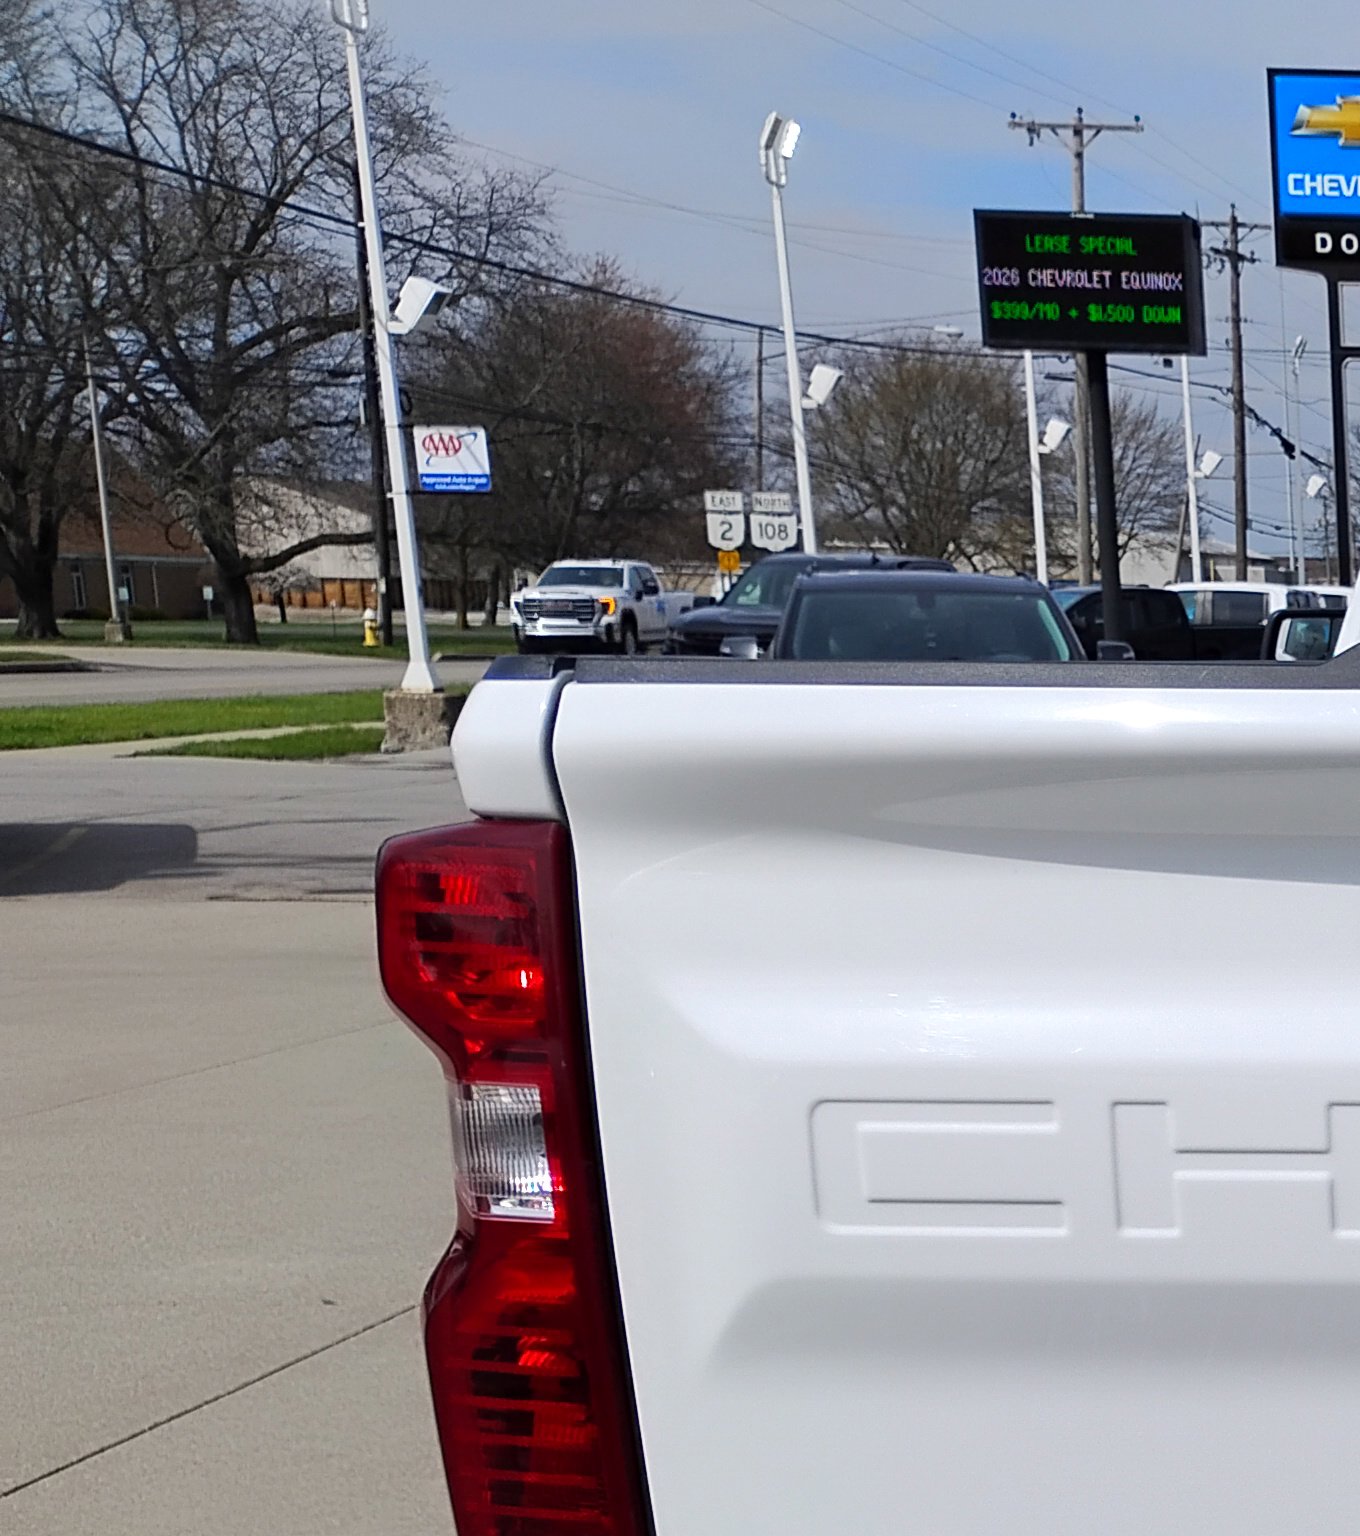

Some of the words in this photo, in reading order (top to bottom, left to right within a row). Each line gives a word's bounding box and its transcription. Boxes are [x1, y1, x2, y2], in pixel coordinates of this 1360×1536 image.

[1025, 234, 1071, 254] LEASE
[1079, 235, 1138, 256] SPECIAL
[1027, 267, 1113, 290] CHEVROLET
[1120, 271, 1184, 292] EQUINOX
[1142, 305, 1182, 324] DOWN
[710, 495, 736, 508] EAST
[719, 520, 733, 541] 2
[758, 522, 789, 541] 108
